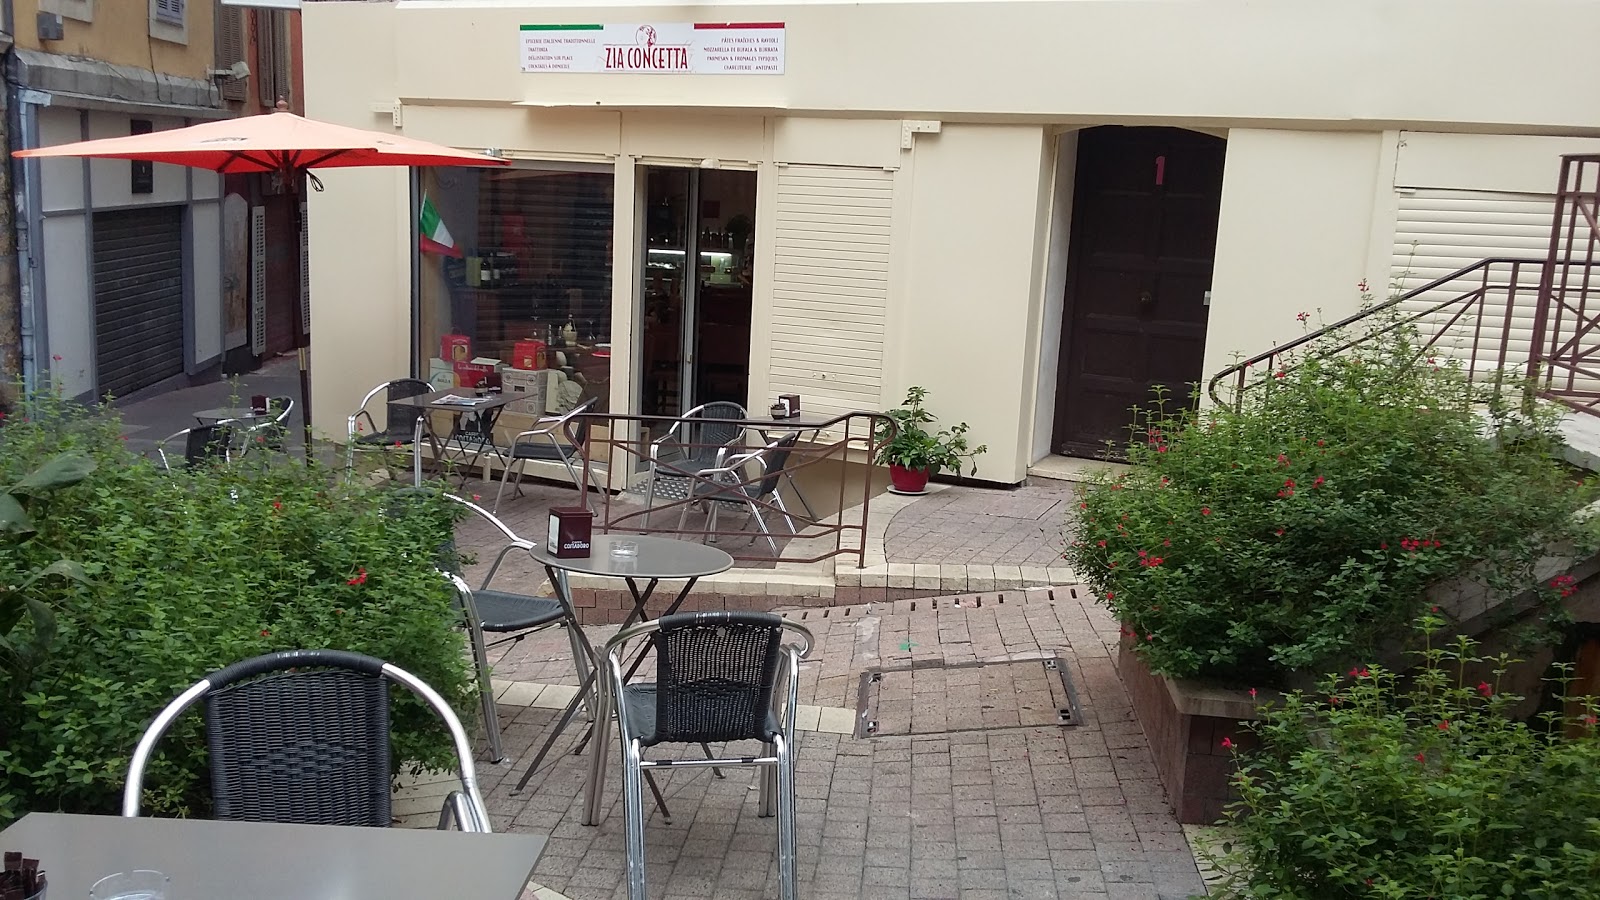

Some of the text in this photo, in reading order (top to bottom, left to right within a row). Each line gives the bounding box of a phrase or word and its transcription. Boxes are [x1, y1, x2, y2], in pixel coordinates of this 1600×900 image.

[605, 47, 688, 69] ZIA CONCETTA
[1155, 155, 1166, 186] 1
